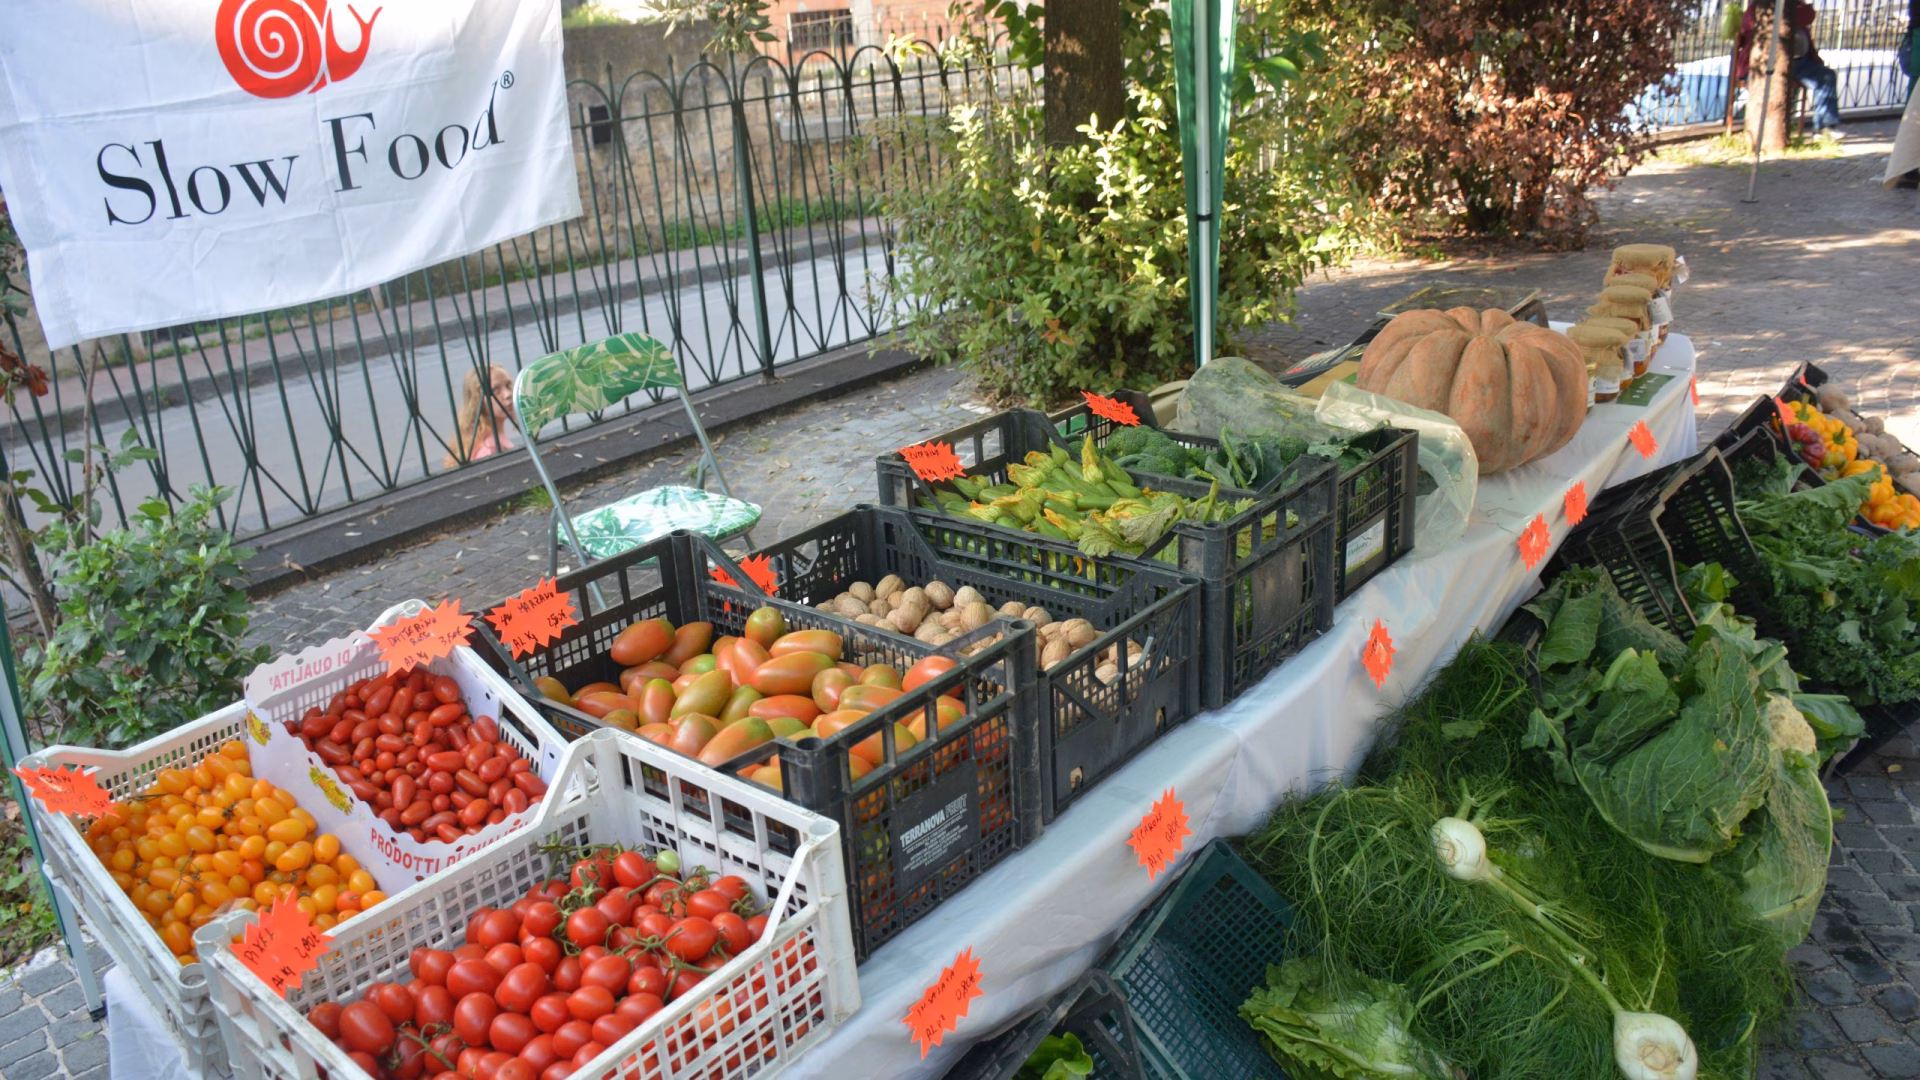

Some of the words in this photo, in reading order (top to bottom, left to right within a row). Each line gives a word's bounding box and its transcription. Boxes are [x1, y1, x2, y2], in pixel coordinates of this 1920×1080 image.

[97, 139, 300, 226] Slow
[518, 591, 555, 614] MARZANO
[900, 809, 946, 848] TERRANOVA
[945, 793, 967, 818] FRUIT
[371, 827, 440, 874] PRODOTTI
